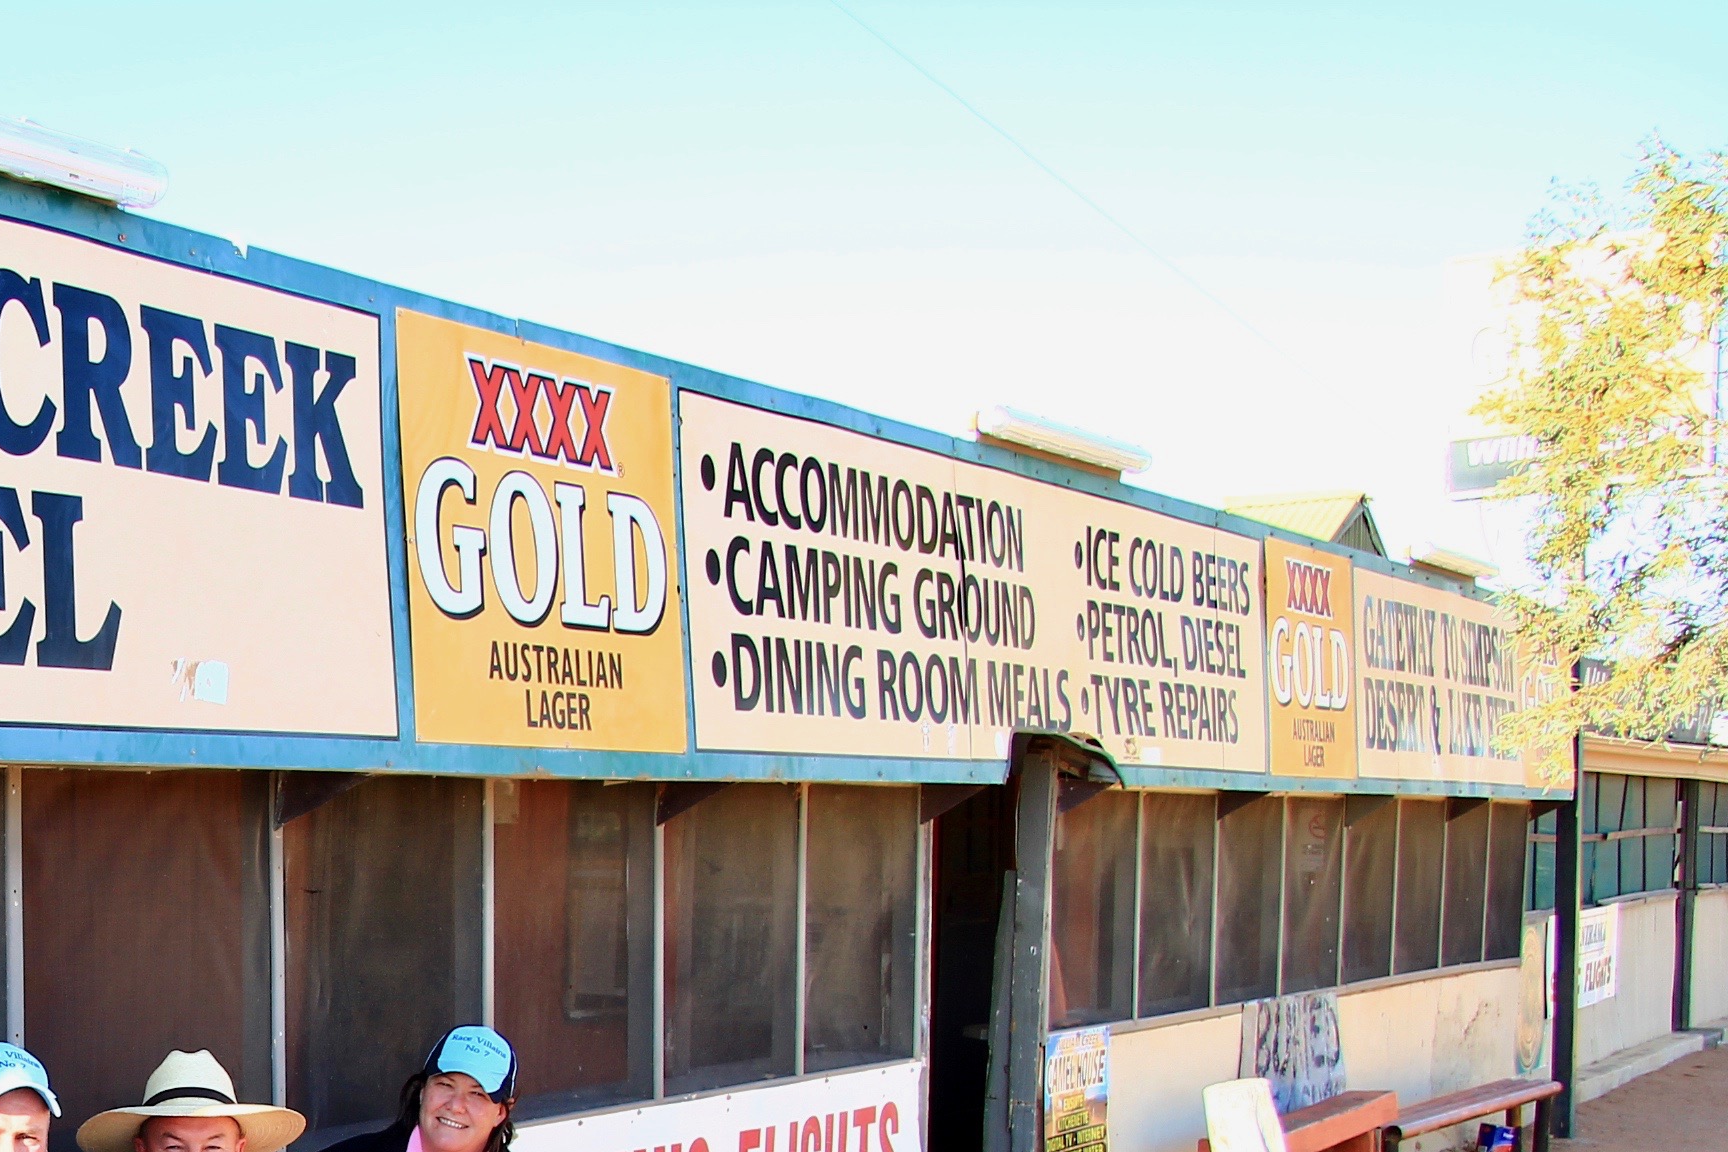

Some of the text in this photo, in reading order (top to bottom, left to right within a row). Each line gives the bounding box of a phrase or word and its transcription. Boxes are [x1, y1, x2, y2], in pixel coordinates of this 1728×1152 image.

[465, 353, 615, 475] XXXX
[724, 441, 1024, 573] ACCOMMODATION
[414, 456, 668, 636] GOLD
[1085, 525, 1251, 617] ICE COLD BEERS
[726, 535, 1036, 651] CAMPING GROUND
[1286, 558, 1333, 618] XXXX
[488, 640, 624, 691] AUSTRALIAN
[1086, 599, 1247, 679] PETROL, DIESEL
[1272, 616, 1350, 711] GOLD
[1363, 594, 1515, 693] GATEWAY TO SIMPSON
[525, 687, 593, 732] LAGER
[731, 633, 1072, 733] DINING ROOM MEALS
[1090, 673, 1239, 745] TYRE REPAIRS
[1292, 717, 1336, 743] AUSTRALIAN
[1363, 676, 1425, 754] DESERT
[1429, 684, 1442, 756] &
[1447, 687, 1484, 758] LAKE
[1303, 744, 1326, 768] LAGER
[1583, 955, 1612, 993] FLIGHTS
[4, 1050, 41, 1069] Villains
[452, 1033, 507, 1059] Race Villains
[465, 1044, 480, 1054] No
[1047, 1049, 1106, 1096] CAMEL HOUSE
[1076, 1125, 1106, 1145] INTERNET
